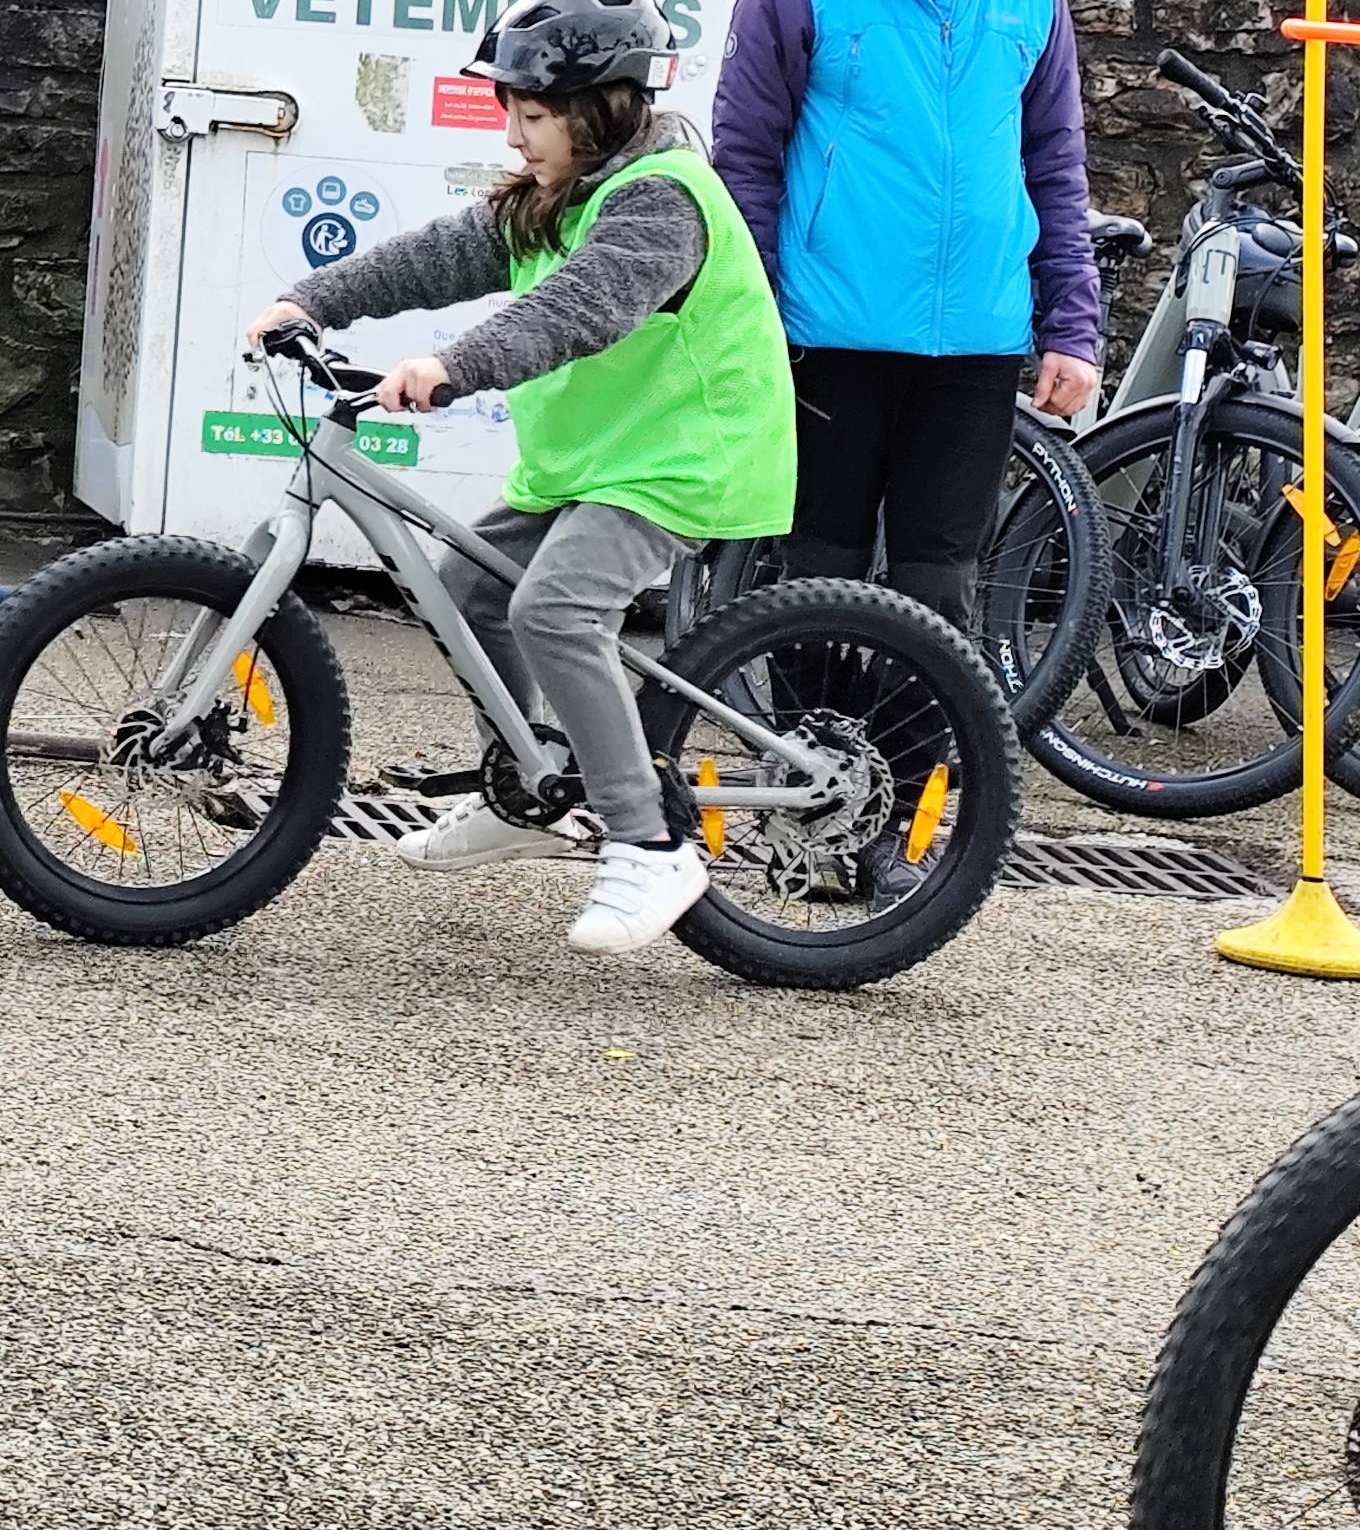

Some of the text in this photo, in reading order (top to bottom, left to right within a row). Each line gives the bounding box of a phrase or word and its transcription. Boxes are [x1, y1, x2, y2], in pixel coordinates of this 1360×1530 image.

[359, 435, 382, 452] 03
[386, 437, 409, 454] 28
[1032, 442, 1077, 512] PYTHON
[1042, 730, 1148, 790] HUTCHINSON
